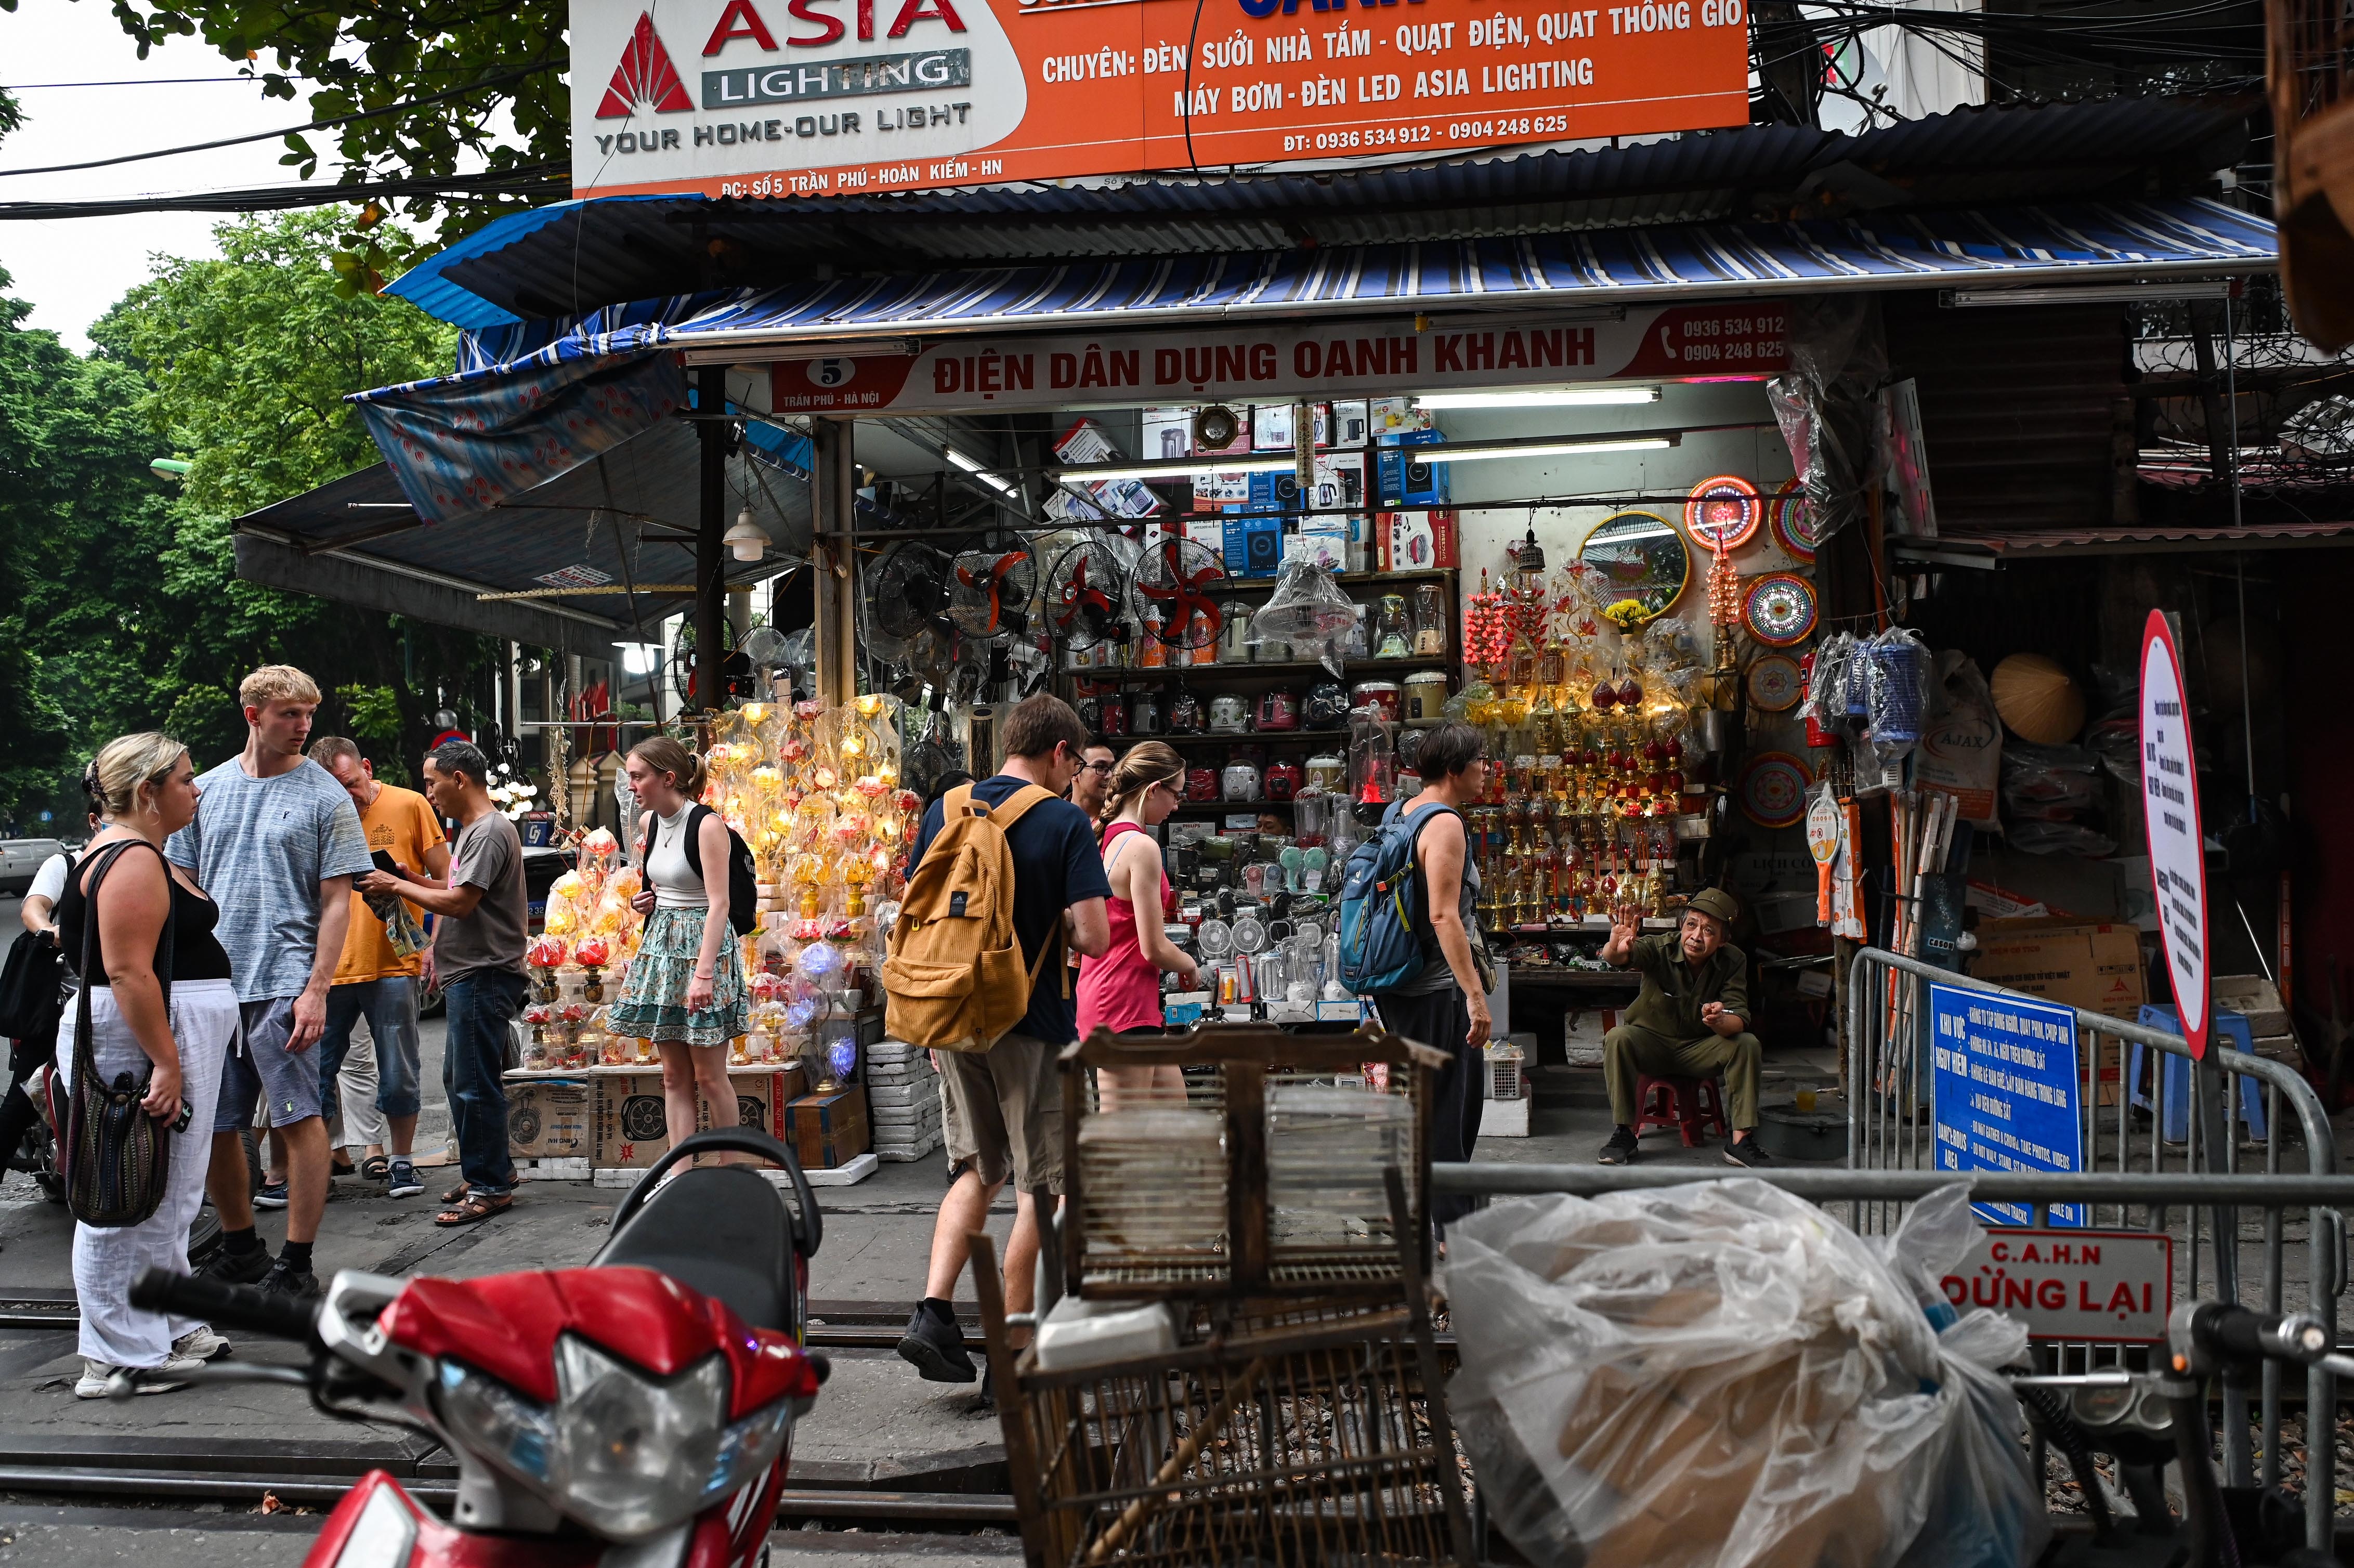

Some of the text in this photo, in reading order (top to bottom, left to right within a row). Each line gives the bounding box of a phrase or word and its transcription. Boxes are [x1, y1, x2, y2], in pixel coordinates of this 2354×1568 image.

[701, 0, 967, 56] ASIA
[1042, 46, 1135, 83] CHUYÊN:
[1143, 41, 1186, 74] ĐÈN
[1202, 29, 1254, 69] SƯỞI
[1266, 28, 1313, 64] NHÀ
[1323, 19, 1371, 60] TẮM
[1395, 21, 1455, 56] QUẠT
[1468, 12, 1530, 50] ĐIỆN,
[1608, 0, 1690, 36] THÔNG
[721, 55, 950, 102] LIGHTING
[1174, 58, 1594, 117] MÁY BƠM ĐÈN LED ASIA LIGHTING
[594, 129, 680, 155] YOUR
[877, 102, 971, 130] LIGHT
[1284, 115, 1567, 152] ĐT: 0936 534 912 0904 248 625
[722, 184, 748, 198] ĐC:
[790, 167, 829, 192] TRẦN
[838, 165, 868, 188] PHÚ
[930, 156, 969, 179] KIẾM
[982, 159, 1002, 175] HN
[1684, 316, 1784, 337] 0936 534 912
[1684, 340, 1784, 361] 0904 248 625
[821, 358, 842, 385] 5
[933, 348, 1035, 400] ĐIỆN
[1050, 344, 1139, 389] DÂN
[1155, 343, 1276, 392] DỤNG
[1293, 336, 1418, 378] OANH
[783, 391, 880, 407] TRẦN PHÚ HÀ NỘI
[1941, 733, 1983, 748] AJAX
[1929, 937, 1954, 950] CASON
[1940, 1013, 1966, 1043] KHU VỰC
[2020, 1017, 2031, 1037] QUAY
[1935, 1045, 1967, 1077] NGUY HIỂM
[2025, 1077, 2037, 1100] HÀNG
[2037, 1083, 2053, 1105] TRONG
[2003, 1098, 2011, 1121] SẮT
[1973, 1120, 1979, 1133] DO
[1986, 1124, 2000, 1142] GATHER
[2021, 1139, 2032, 1156] TAKE
[2052, 1151, 2070, 1170] VIDEOS
[1973, 1142, 1979, 1156] DO
[1945, 1148, 1958, 1171] AREA
[2010, 1204, 2027, 1224] TRACKS
[2065, 1205, 2073, 1222] ON
[1991, 1242, 2100, 1265] C.A.H.N
[2079, 1280, 2152, 1320] LẠI
